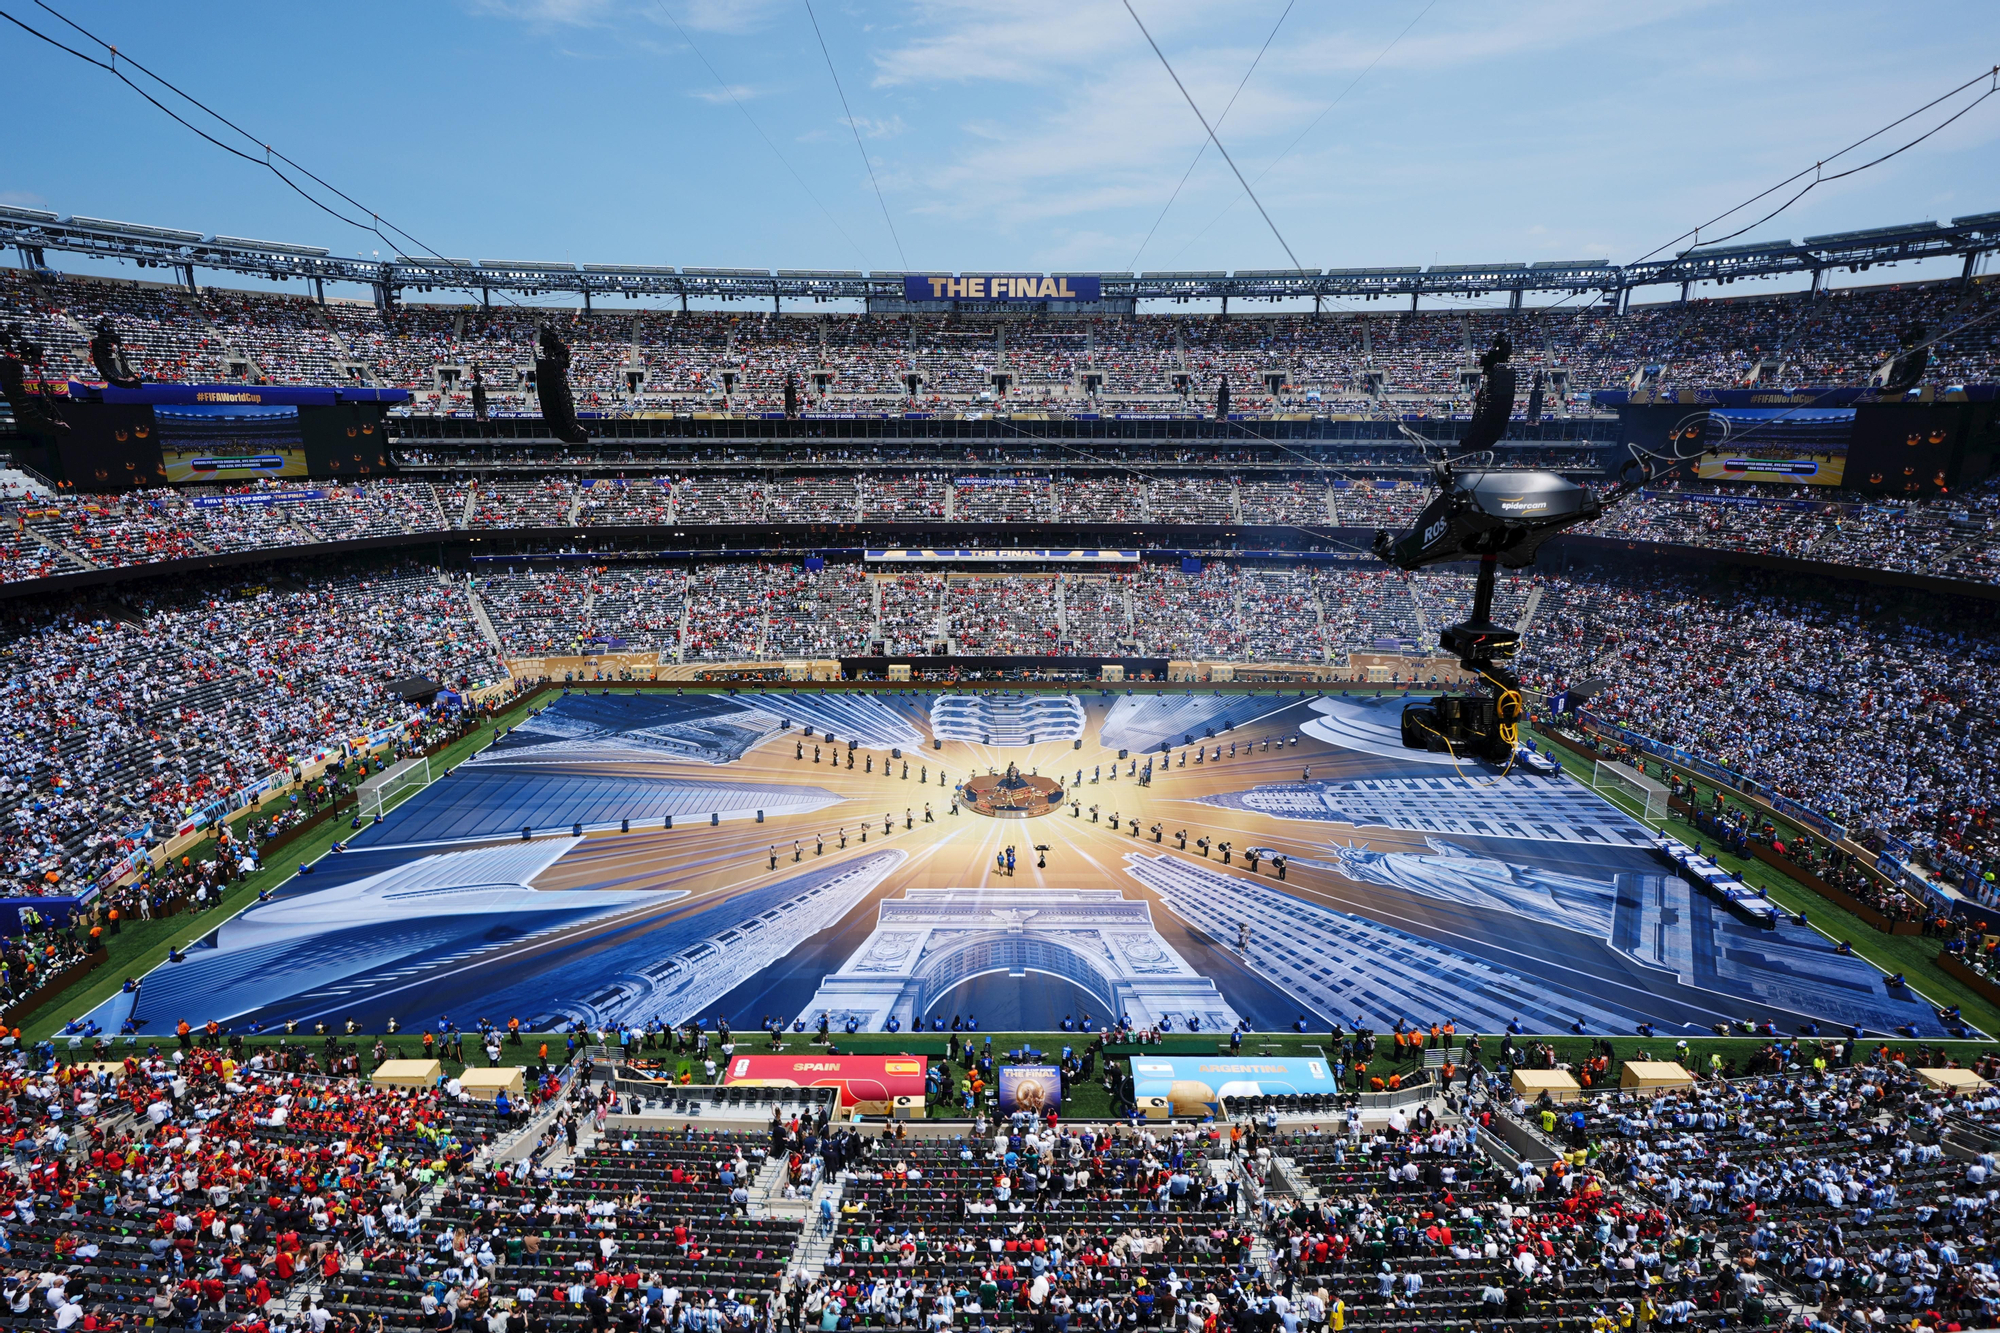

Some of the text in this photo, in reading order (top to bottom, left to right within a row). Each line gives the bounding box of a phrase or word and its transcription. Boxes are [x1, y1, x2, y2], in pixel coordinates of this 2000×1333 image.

[928, 278, 1076, 298] THE FINAL
[196, 392, 261, 403] #FIFAWorldCup
[1750, 394, 1816, 404] #FIFAWorldCup
[1502, 502, 1547, 511] spidercam
[1424, 516, 1447, 543] ROS
[793, 1063, 840, 1071] SPAIN
[1199, 1065, 1288, 1073] ARGENTINA
[861, 1242, 869, 1250] 10
